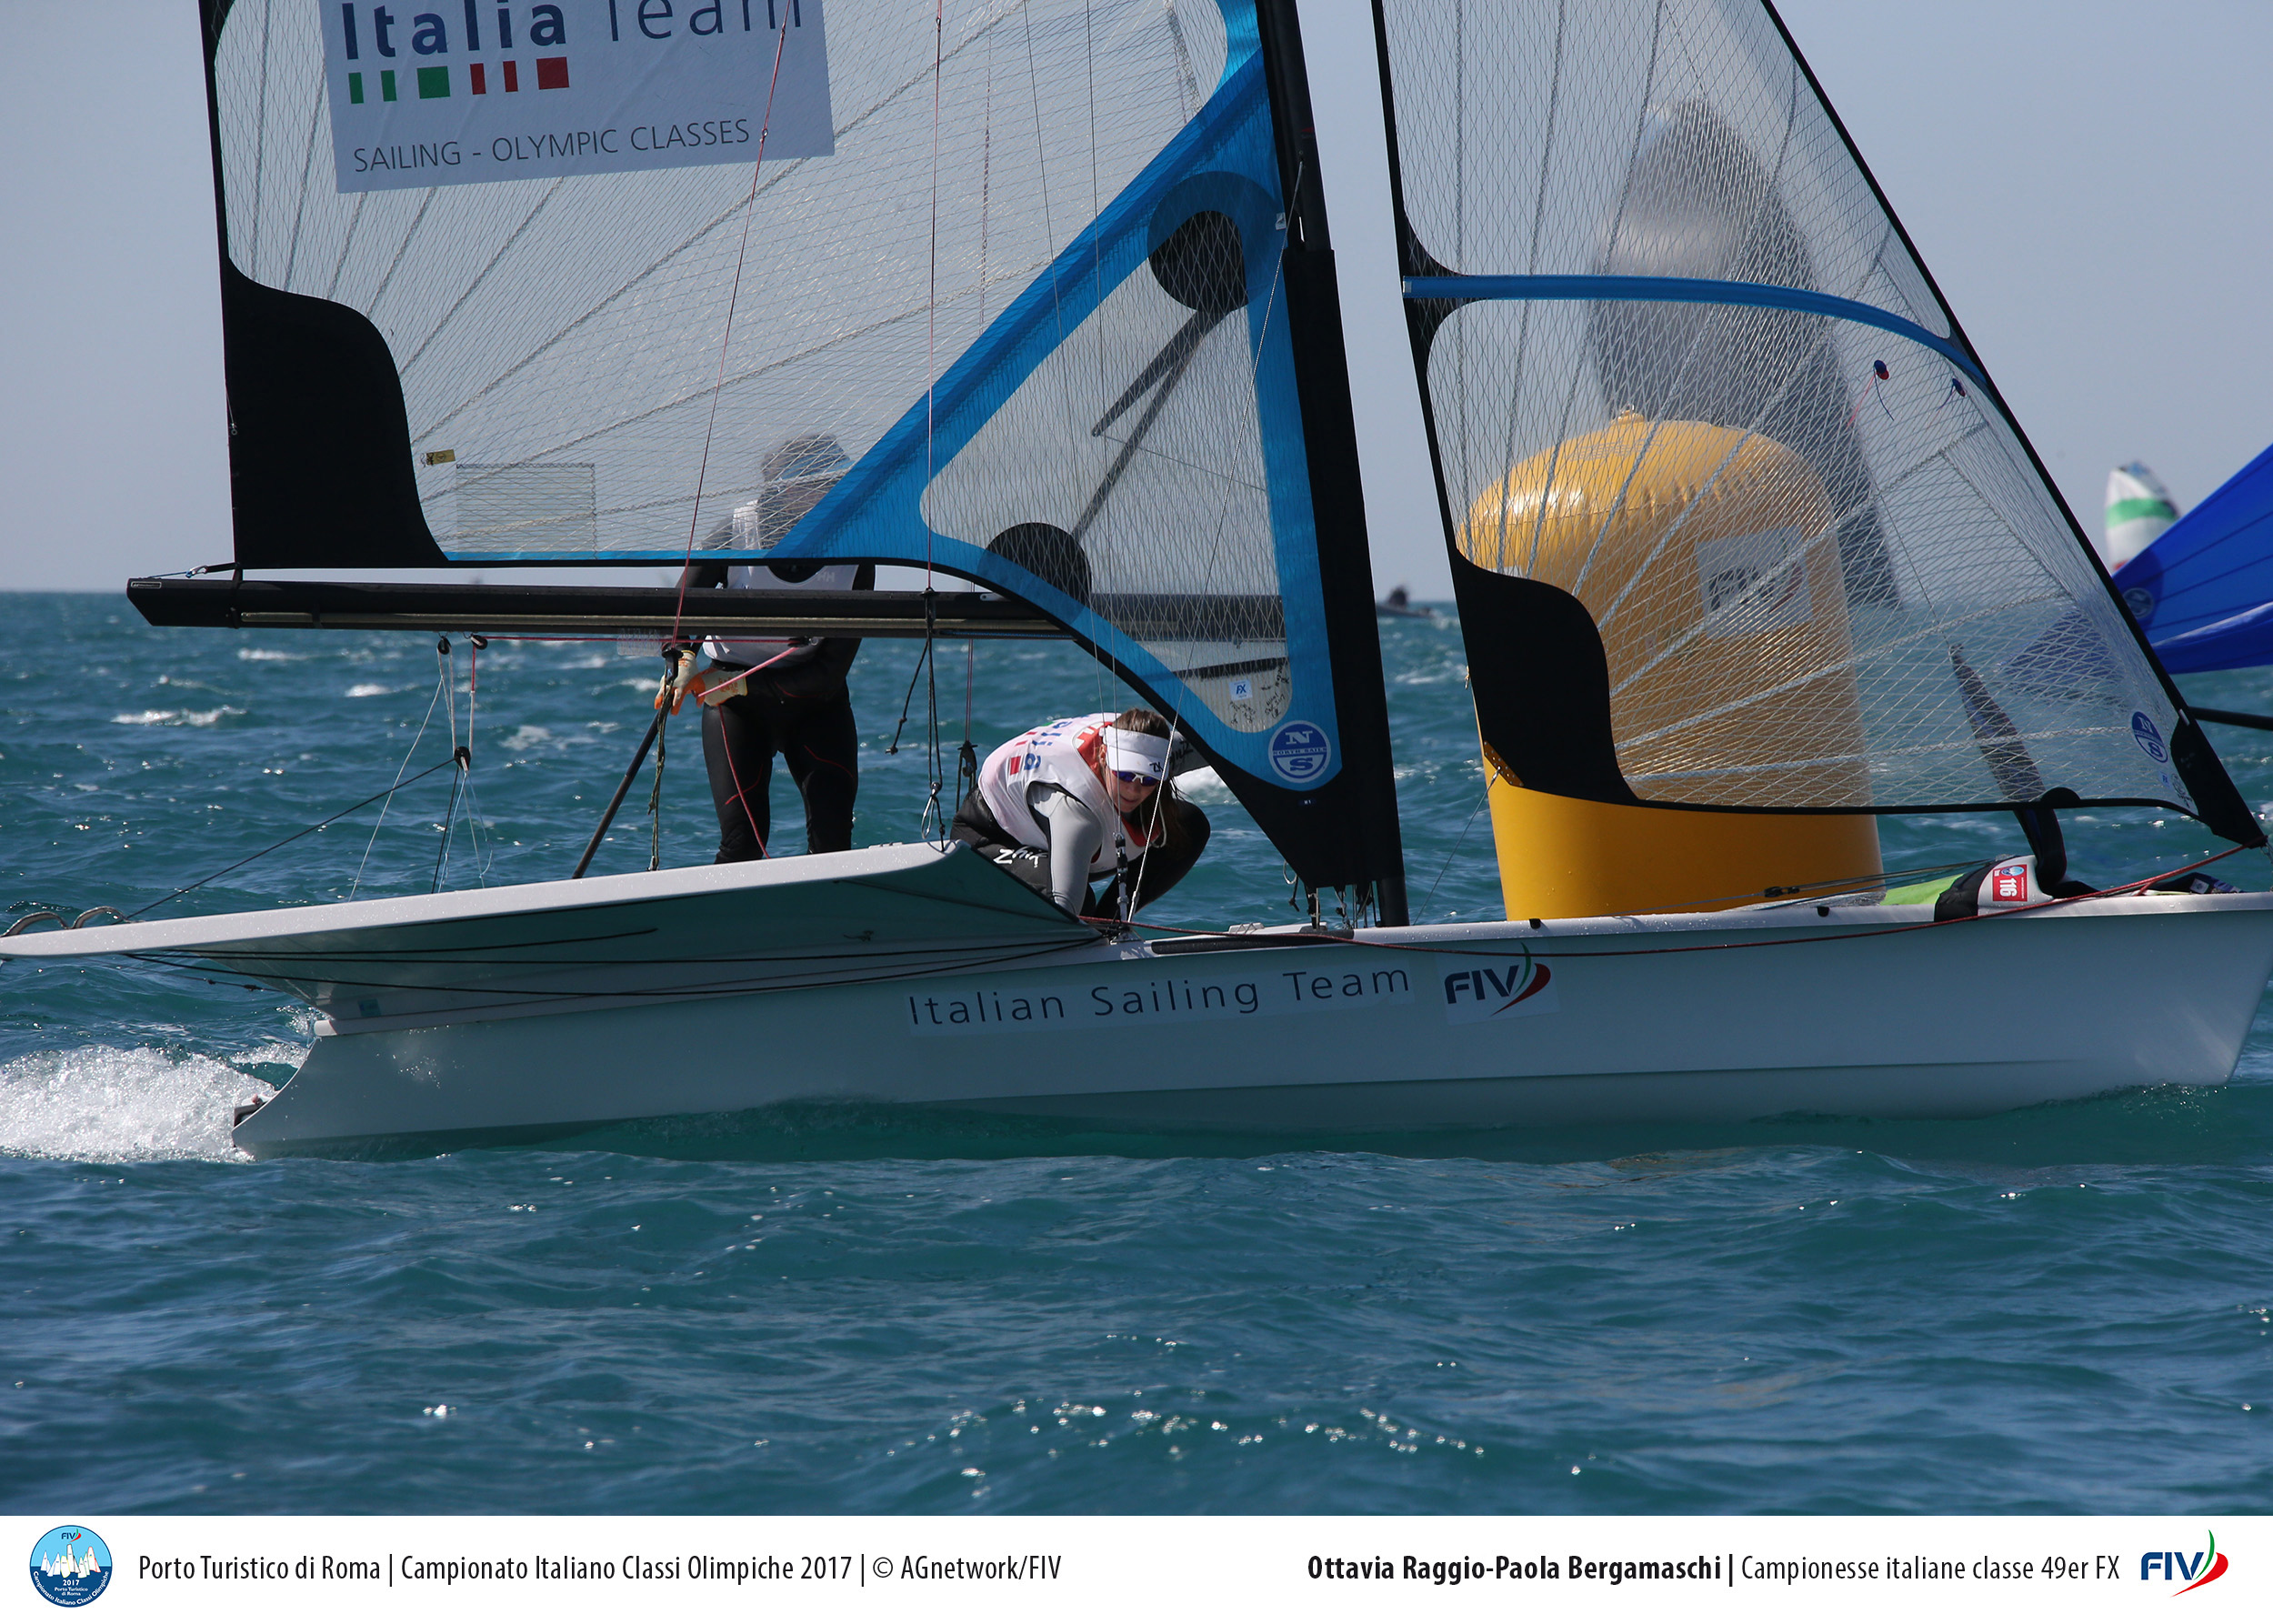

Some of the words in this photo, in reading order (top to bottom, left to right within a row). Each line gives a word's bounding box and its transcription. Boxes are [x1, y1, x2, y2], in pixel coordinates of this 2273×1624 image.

[342, 0, 566, 59] Italia
[354, 142, 461, 172] SAILING
[492, 128, 618, 162] OLYMPIC
[631, 119, 749, 151] CLASSES
[1285, 730, 1313, 745] N
[1289, 757, 1314, 771] S
[1999, 877, 2018, 897] 116
[909, 991, 1065, 1025] Italian
[1091, 980, 1259, 1017] Sailing
[1282, 968, 1409, 1001] Team
[1445, 965, 1519, 1004] FIV
